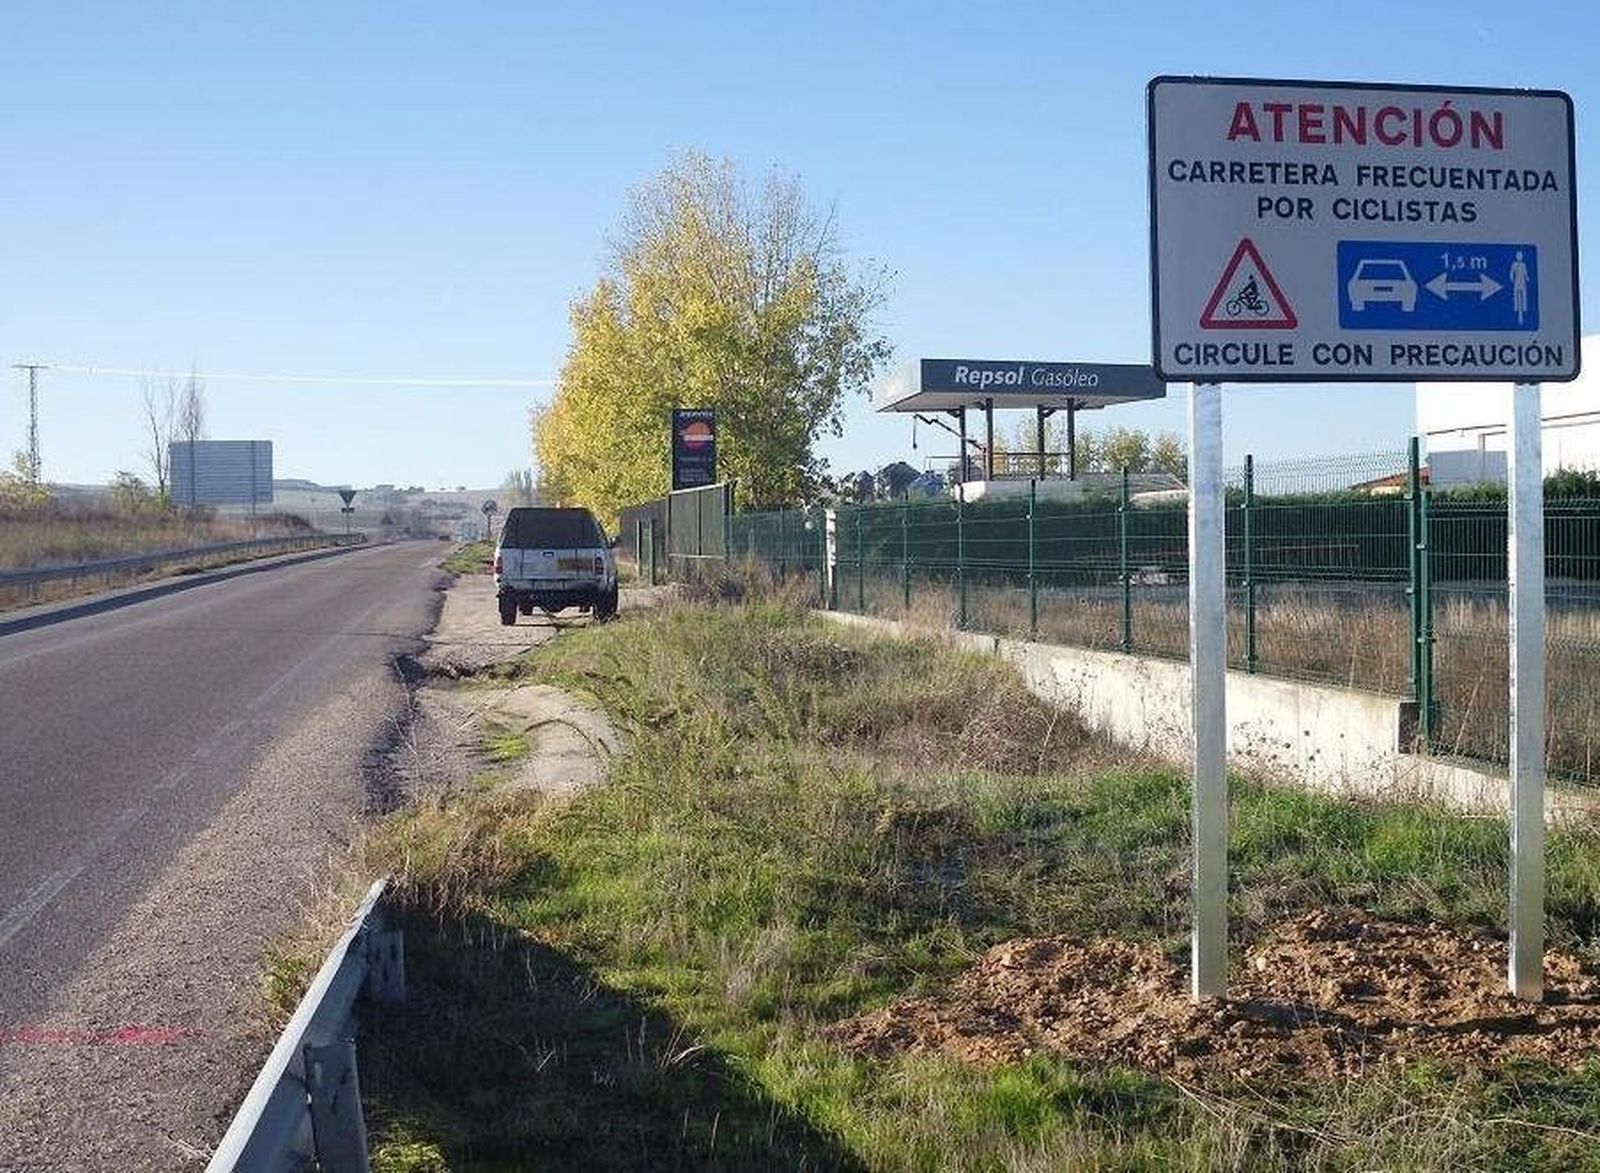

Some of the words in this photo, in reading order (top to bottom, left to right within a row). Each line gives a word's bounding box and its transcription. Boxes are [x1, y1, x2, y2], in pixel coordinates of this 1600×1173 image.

[1227, 101, 1504, 149] ATENCIÓN
[1168, 159, 1338, 186] CARRETERA
[1356, 165, 1559, 192] FRECUENTADA
[1257, 197, 1313, 219] POR
[1332, 198, 1477, 222] CICLISTAS
[1471, 256, 1488, 269] m
[1174, 343, 1294, 365] CIRCULE
[1312, 343, 1373, 366] CON
[1390, 340, 1563, 366] PRECAUCIÓN
[955, 366, 1024, 389] Repsol
[1031, 368, 1099, 387] Gasóleo
